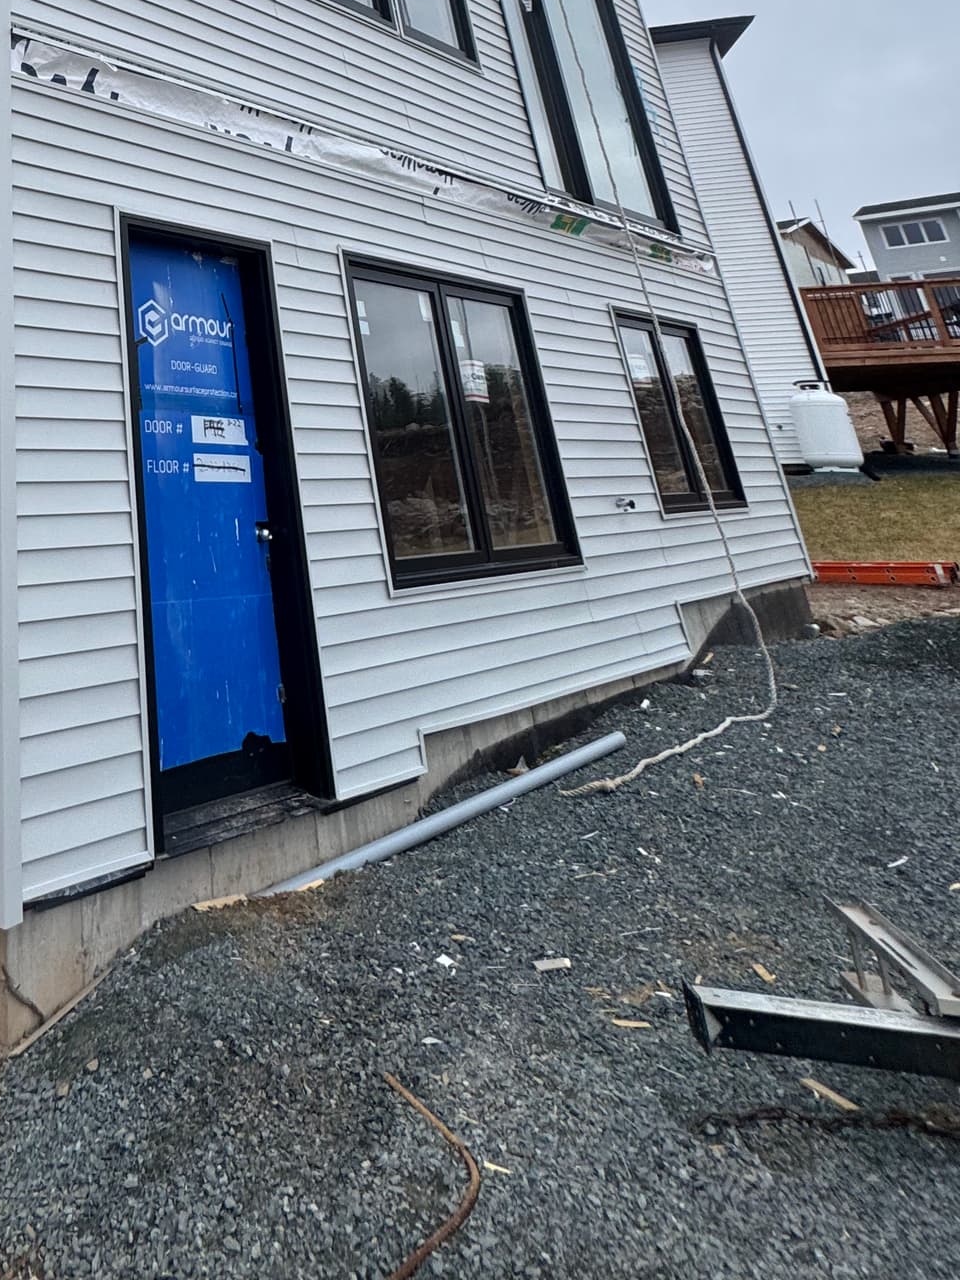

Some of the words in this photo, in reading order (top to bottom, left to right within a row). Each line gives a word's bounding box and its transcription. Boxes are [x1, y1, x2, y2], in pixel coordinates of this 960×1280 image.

[170, 313, 232, 338] armour
[170, 359, 218, 374] DOOR-GUARD
[144, 419, 173, 434] DOOR
[146, 459, 180, 474] FLOOR
